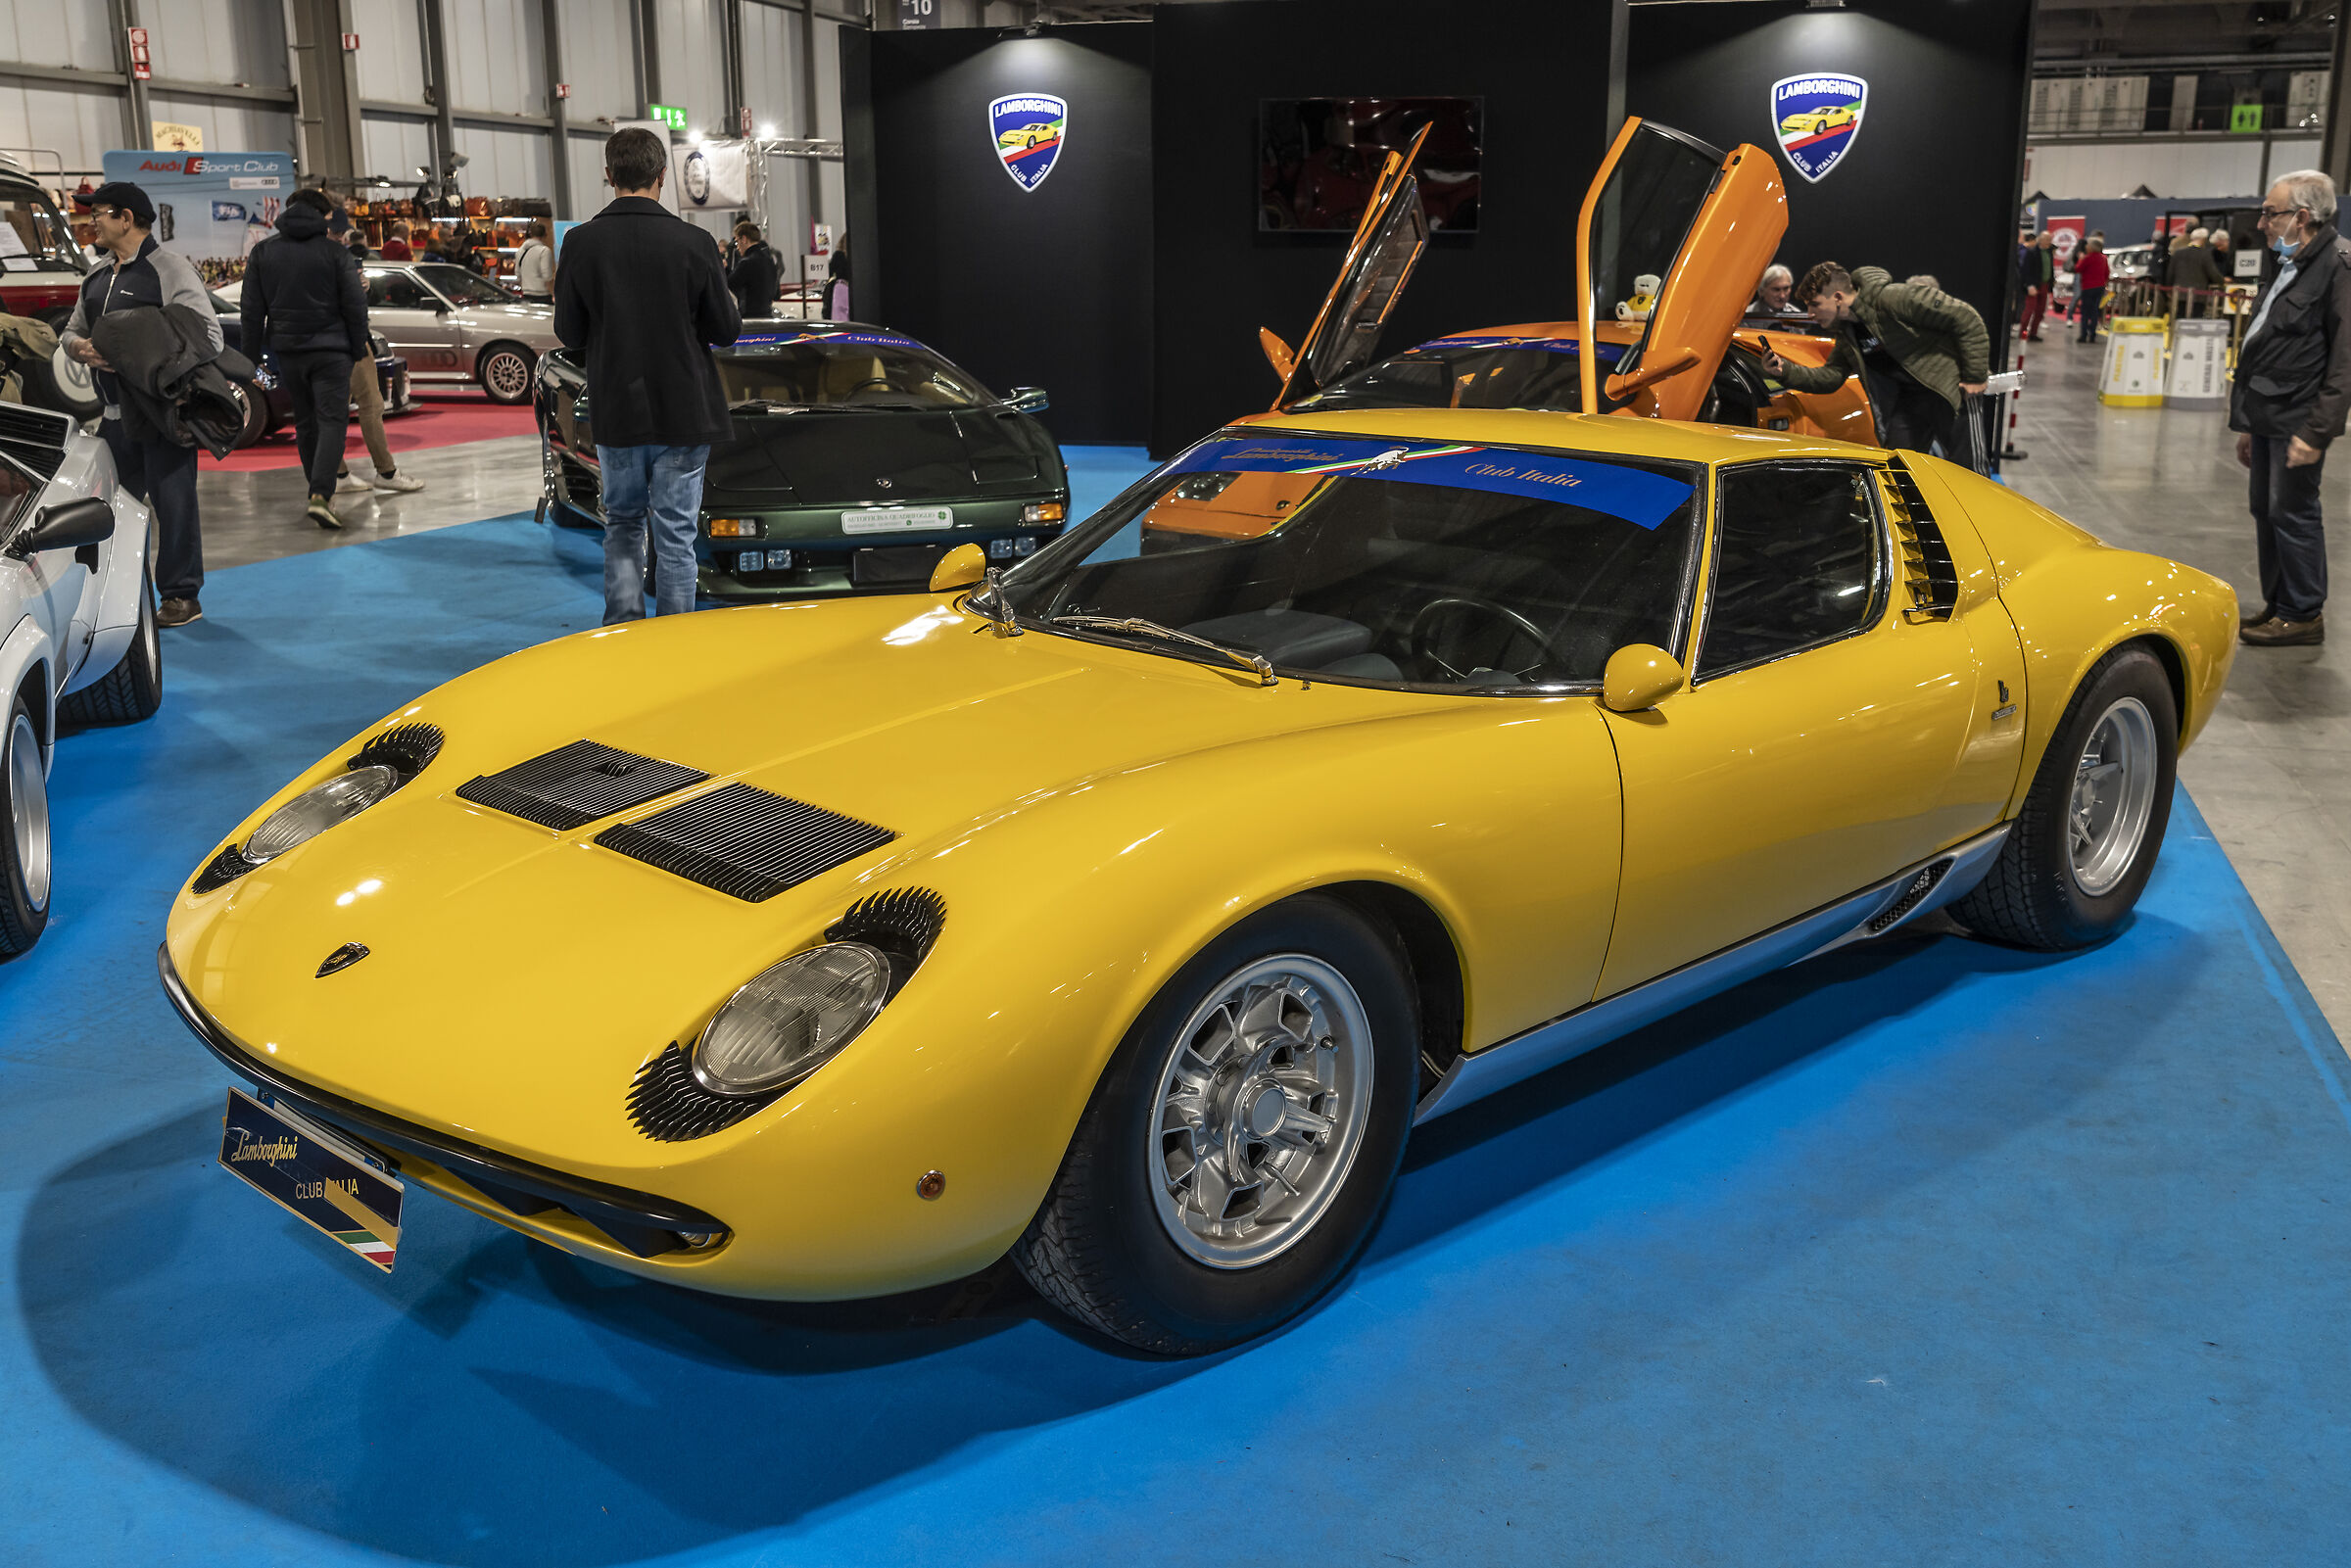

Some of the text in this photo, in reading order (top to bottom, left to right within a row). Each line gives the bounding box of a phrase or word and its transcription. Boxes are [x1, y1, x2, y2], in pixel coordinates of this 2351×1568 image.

[911, 0, 933, 16] 10
[1778, 79, 1861, 101] LAMBORGHINI
[994, 99, 1061, 118] LAMBORGHINI
[139, 160, 279, 172] Audi Sport Club
[1793, 151, 1839, 173] CLUB ITALIA
[1010, 164, 1048, 184] CLUB ITALIA
[1464, 462, 1516, 478] Club
[1516, 469, 1583, 488] Italia
[230, 1130, 298, 1167] Lamborghini
[295, 1181, 323, 1200] CLUB
